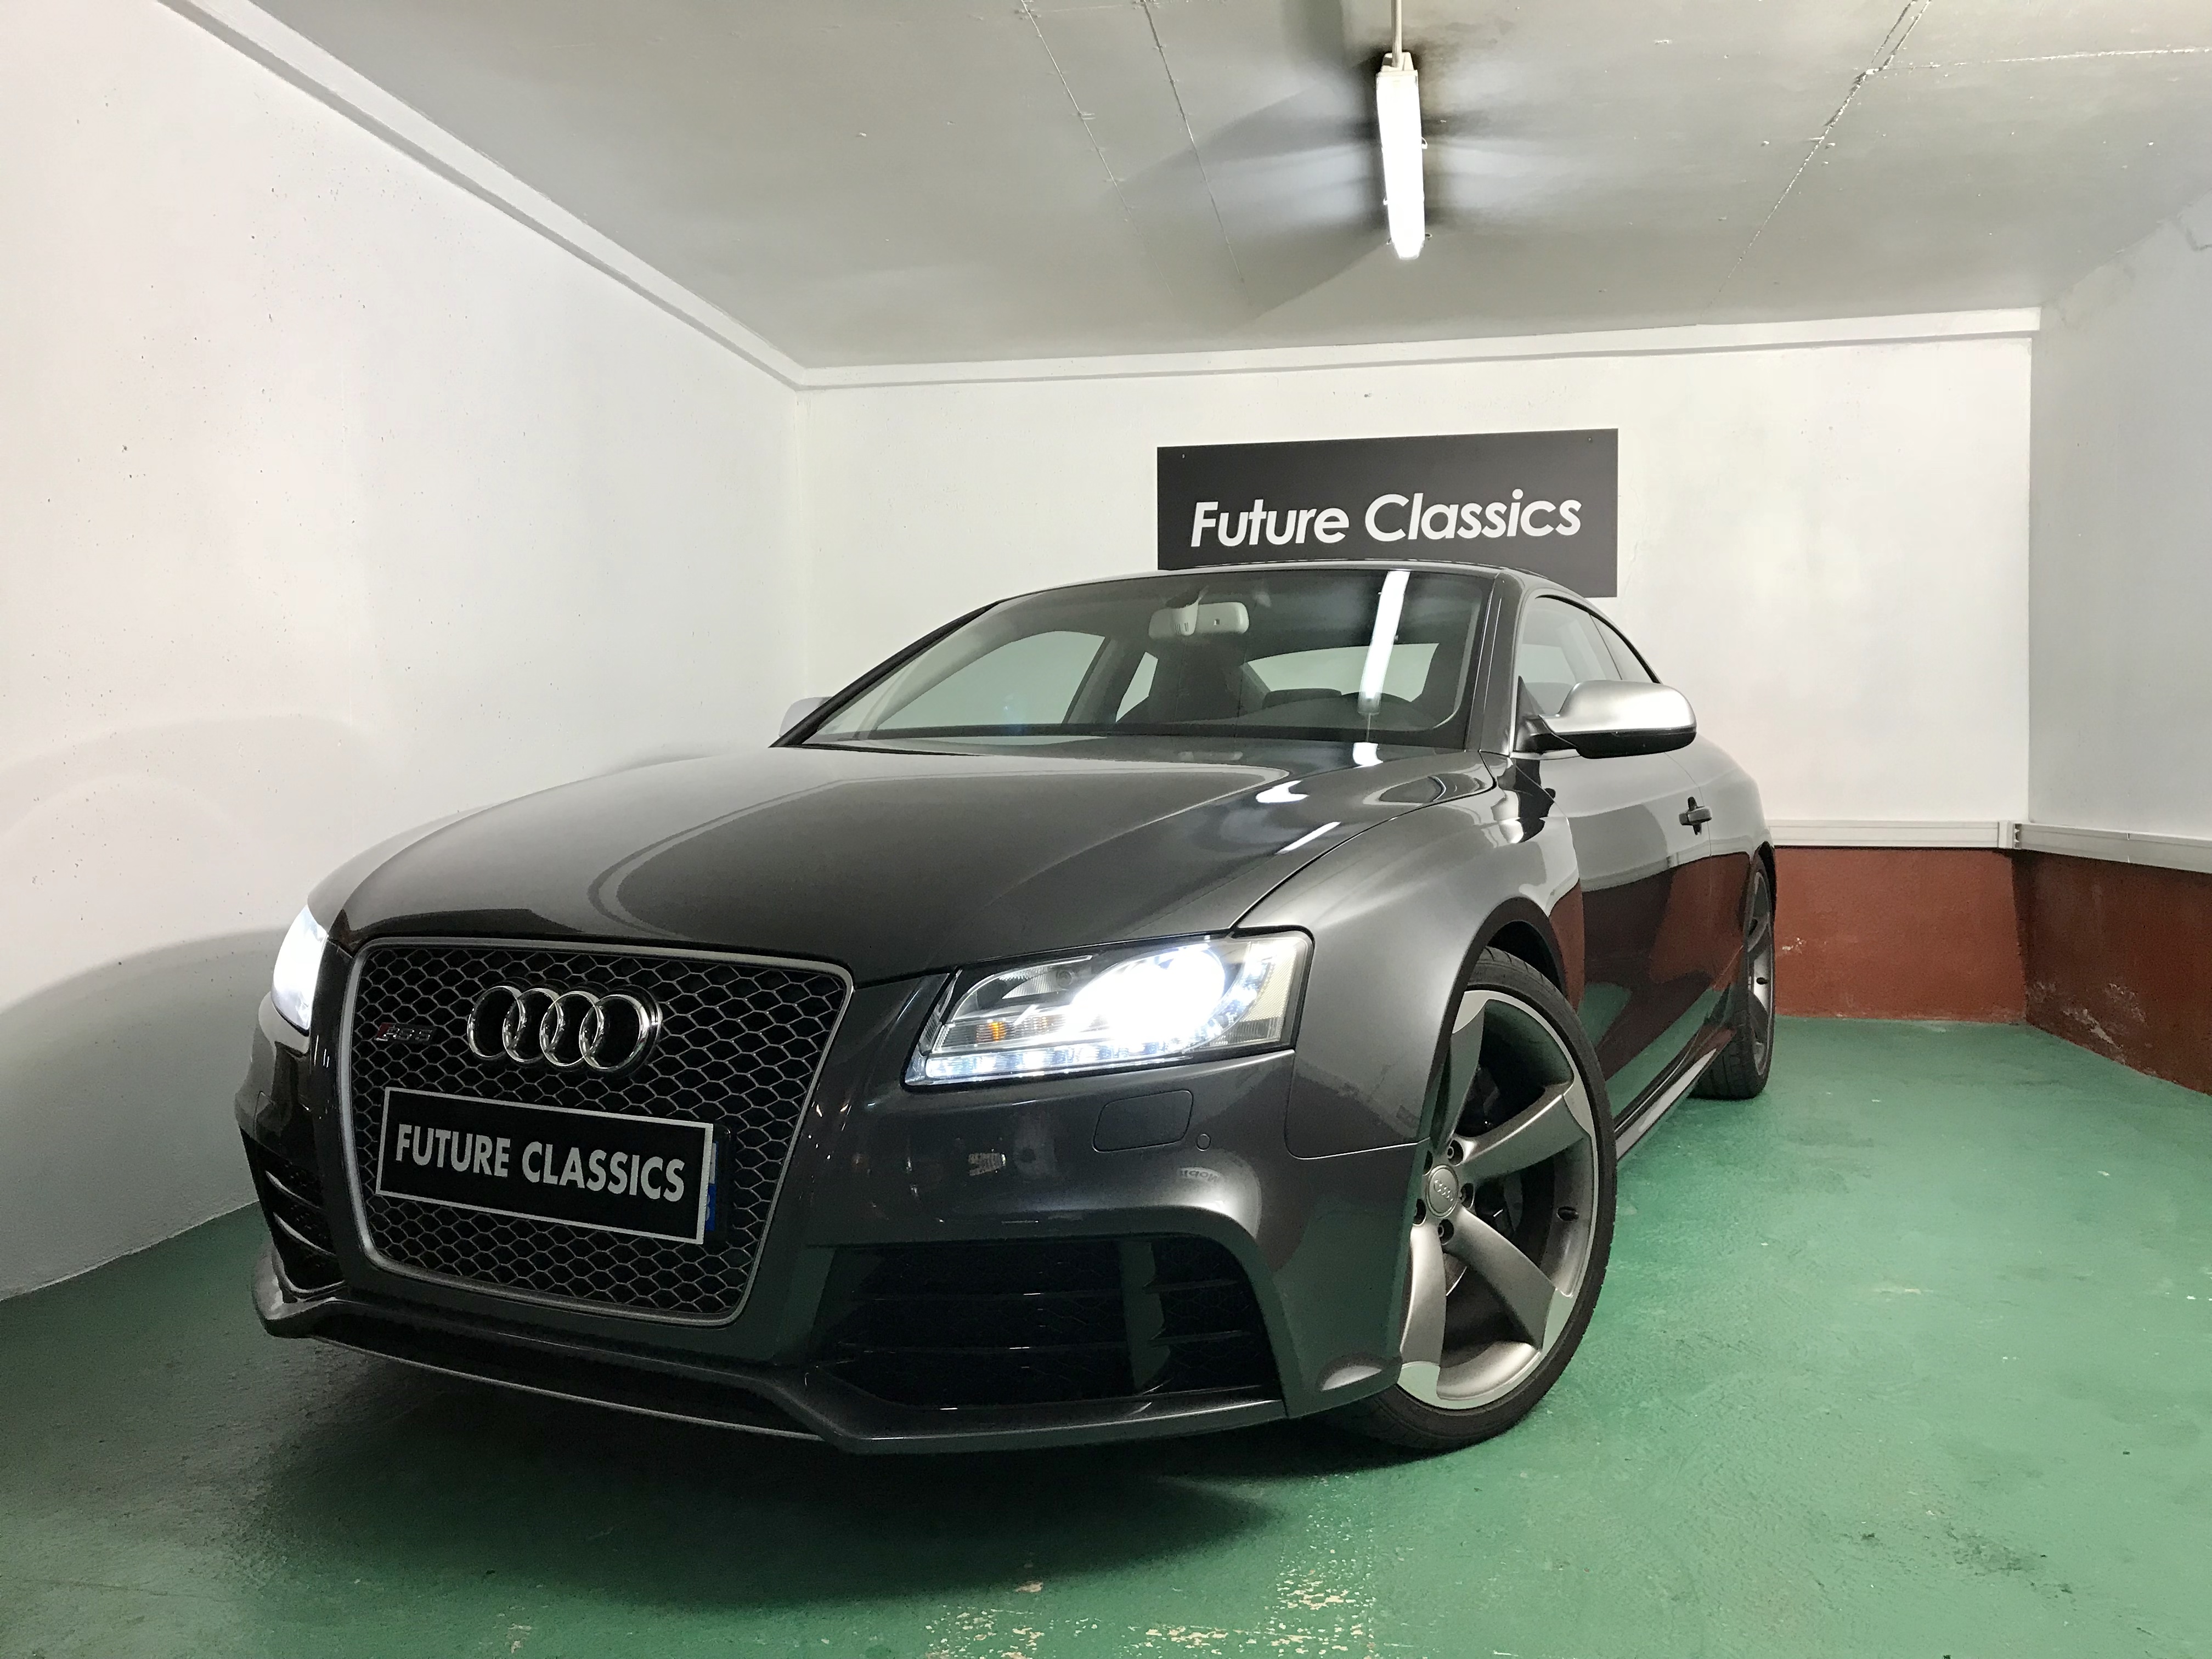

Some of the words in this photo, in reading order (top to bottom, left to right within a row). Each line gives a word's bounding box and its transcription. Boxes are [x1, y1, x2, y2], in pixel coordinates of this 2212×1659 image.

[1190, 499, 1350, 548] Future
[1364, 488, 1582, 542] Classics
[396, 1124, 511, 1178] FUTURE
[522, 1141, 685, 1203] CLASSICS
